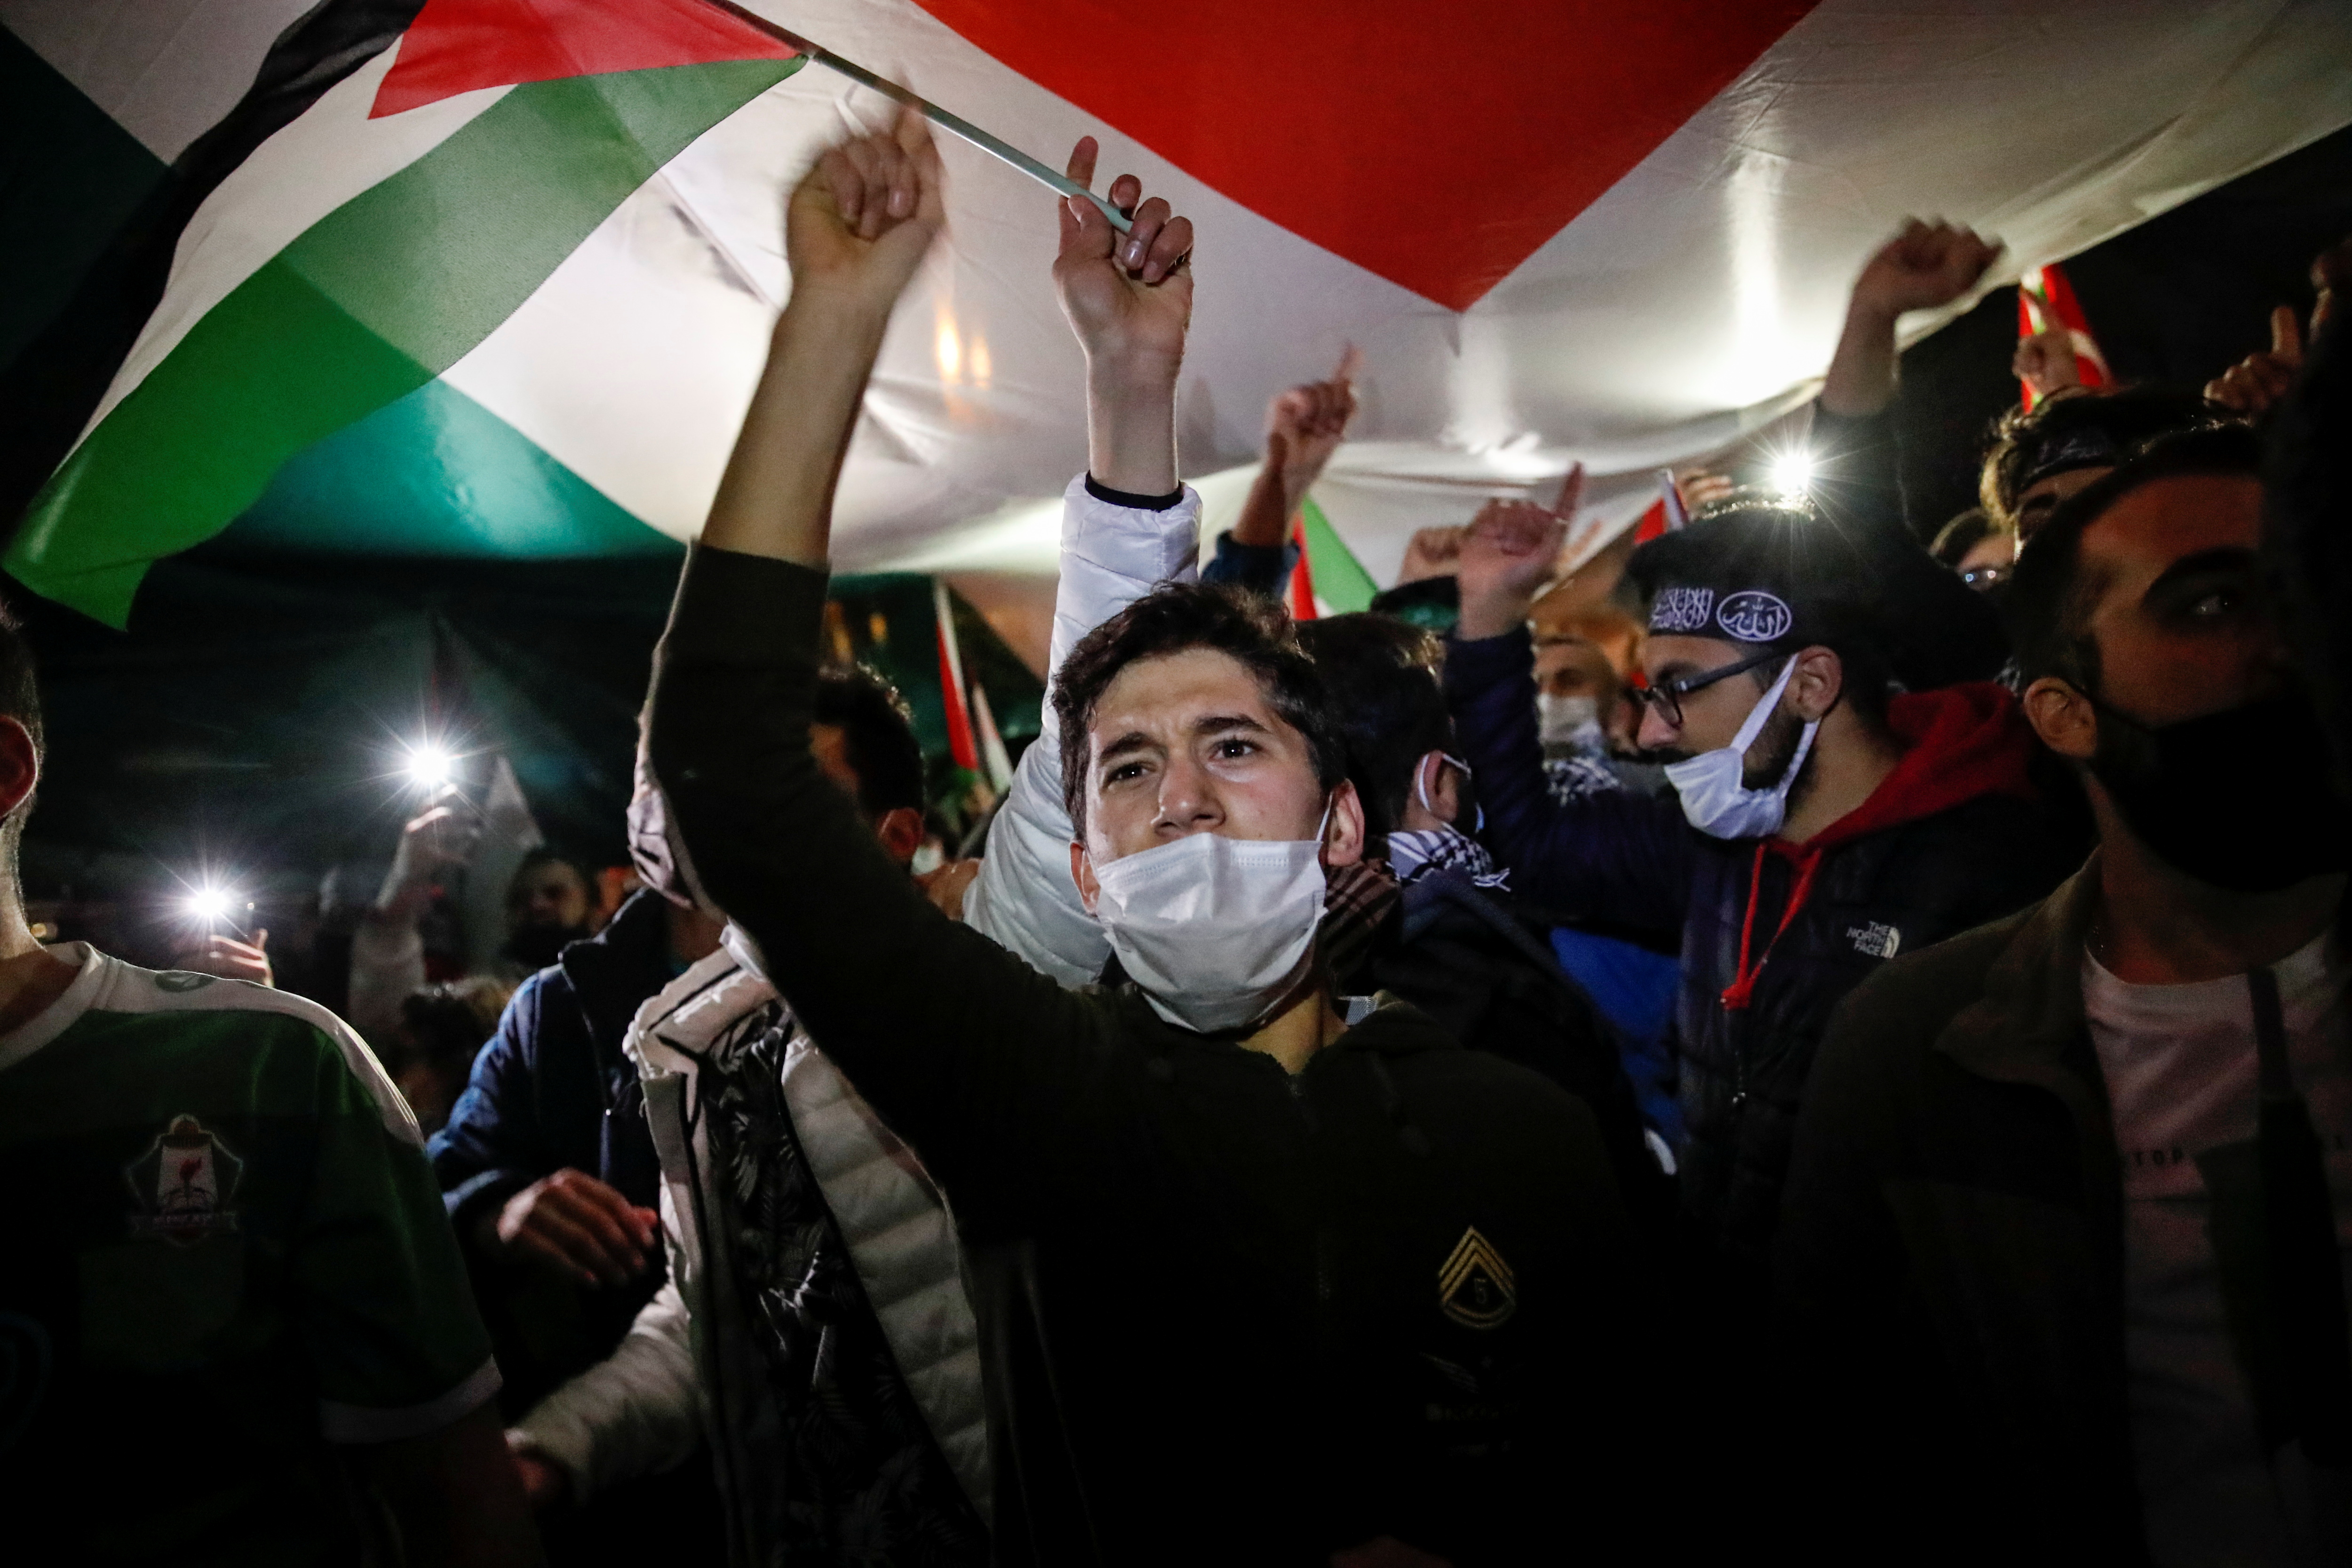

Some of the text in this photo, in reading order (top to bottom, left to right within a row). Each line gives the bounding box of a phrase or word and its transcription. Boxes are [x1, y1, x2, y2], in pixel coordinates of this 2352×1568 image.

[1846, 927, 1886, 946] NORTH
[1868, 921, 1890, 936] THE
[1854, 939, 1882, 956] FACE
[1473, 1277, 1488, 1305] 5
